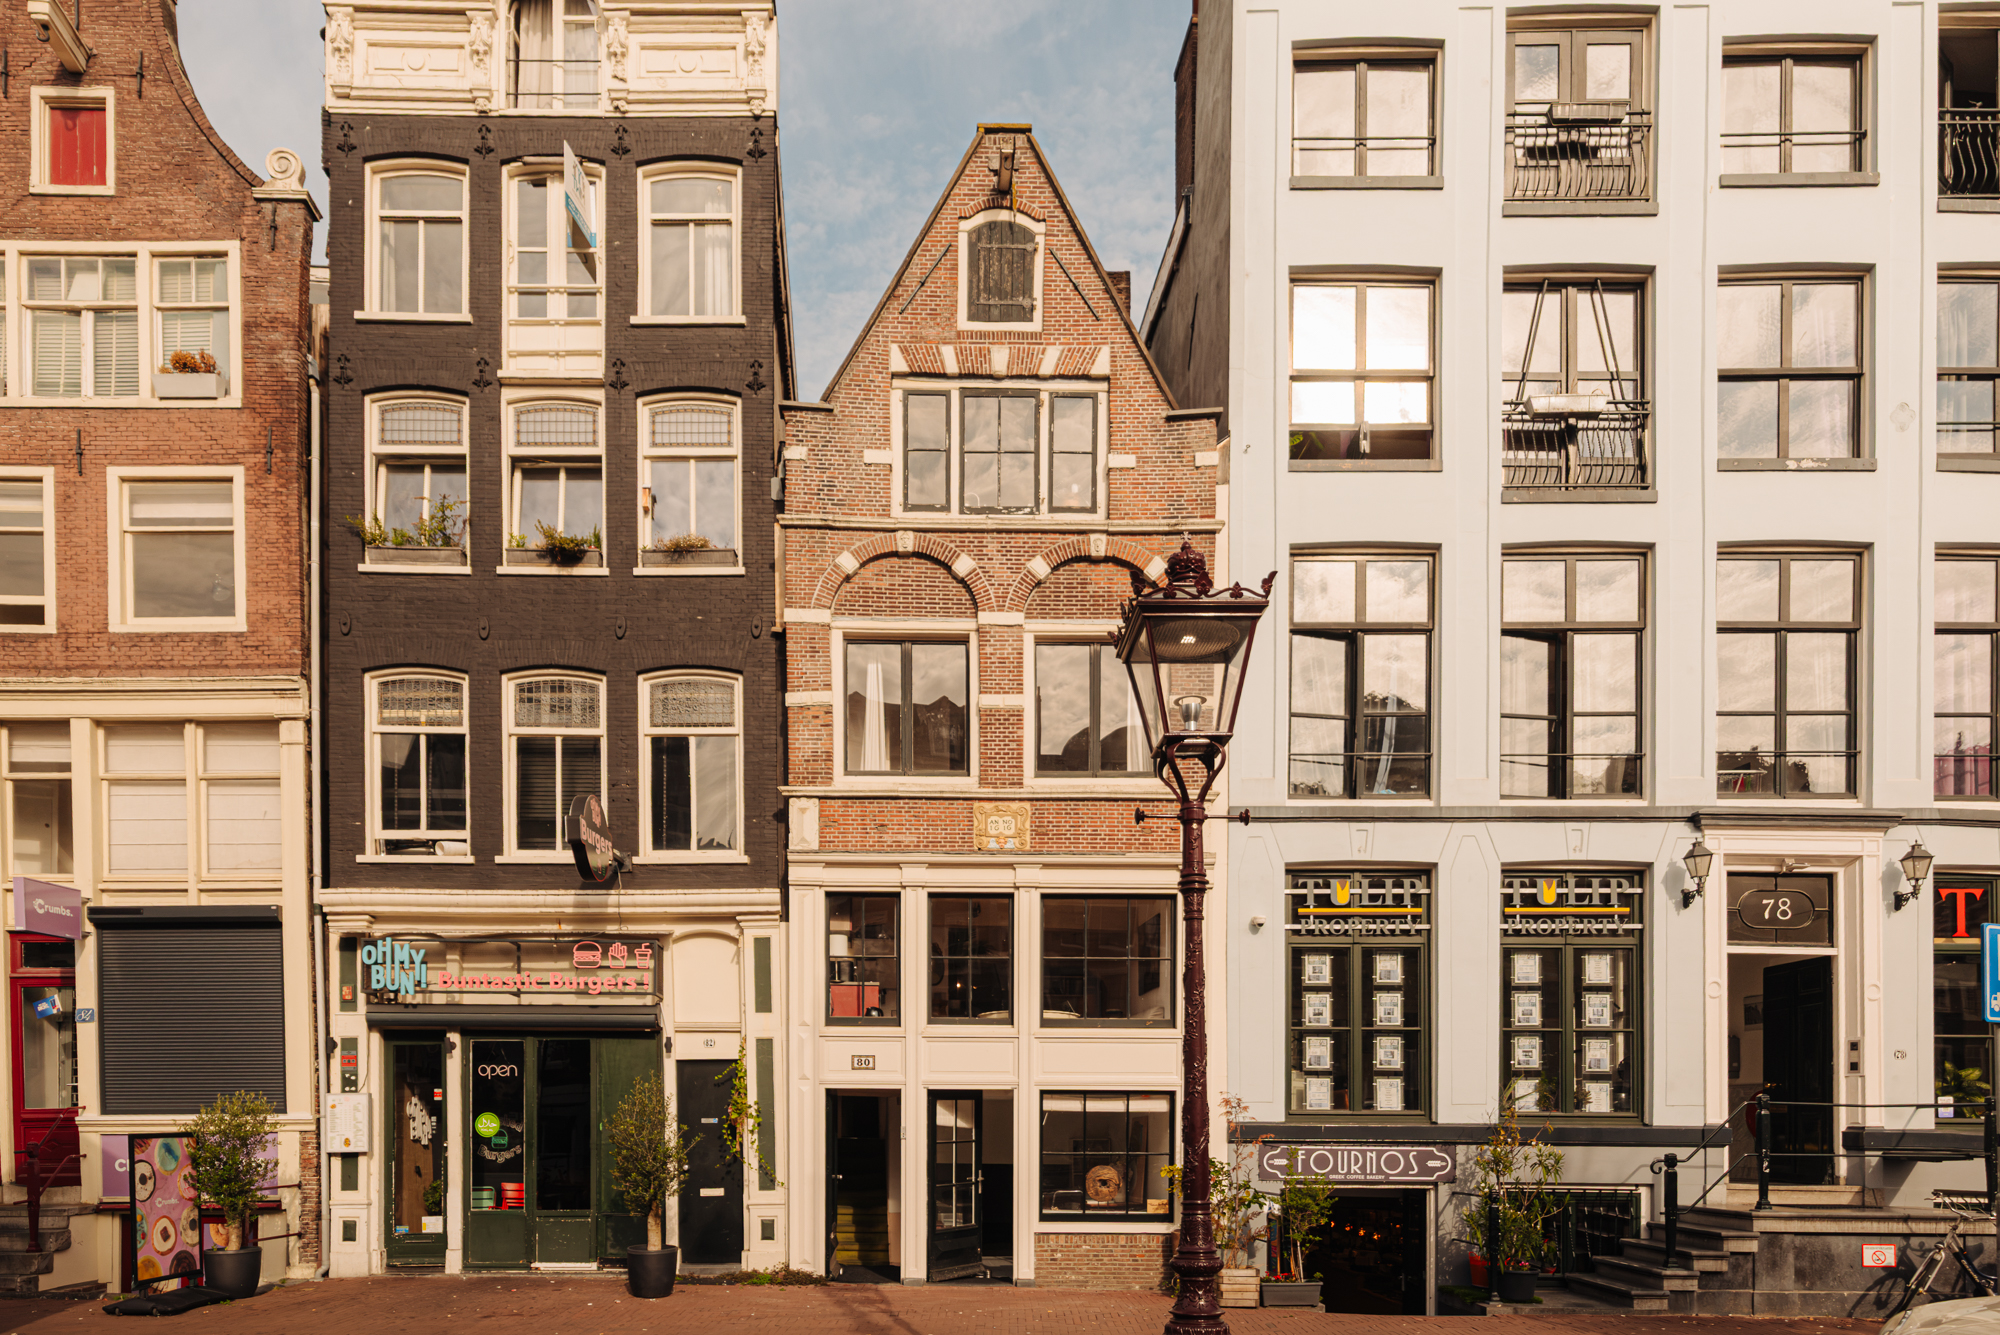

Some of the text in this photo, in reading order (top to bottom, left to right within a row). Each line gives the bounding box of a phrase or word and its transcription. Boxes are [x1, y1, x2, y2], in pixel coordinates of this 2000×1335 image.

[580, 818, 613, 857] Burgers
[1298, 878, 1423, 906] TULIP
[1504, 878, 1630, 906] TULIP
[33, 898, 74, 917] Crumbs.
[1762, 897, 1792, 920] 78
[1938, 888, 1985, 937] T
[1299, 918, 1421, 935] PROPERTY
[1506, 918, 1629, 935] PROPERTY
[438, 971, 543, 989] Buntastic
[549, 972, 637, 995] Burgers
[478, 1064, 518, 1080] open
[856, 1058, 871, 1066] 80
[477, 1143, 522, 1163] Burgers
[1297, 1150, 1418, 1174] FOURNOS
